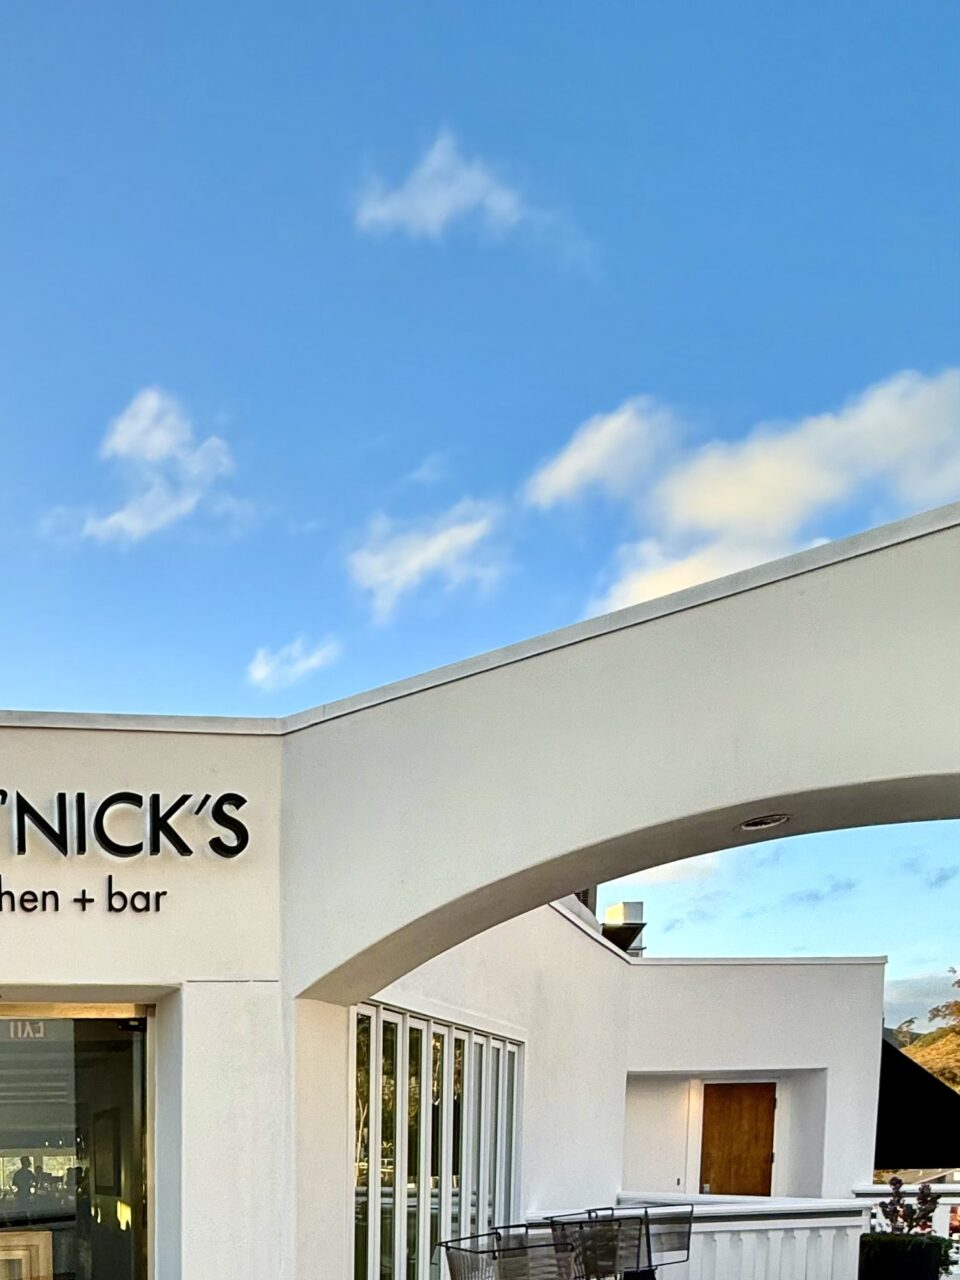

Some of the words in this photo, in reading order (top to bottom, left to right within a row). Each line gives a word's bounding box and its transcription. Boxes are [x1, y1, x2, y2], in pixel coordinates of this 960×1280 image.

[16, 791, 250, 859] NICK'S
[73, 890, 95, 912] +
[107, 875, 168, 913] bar
